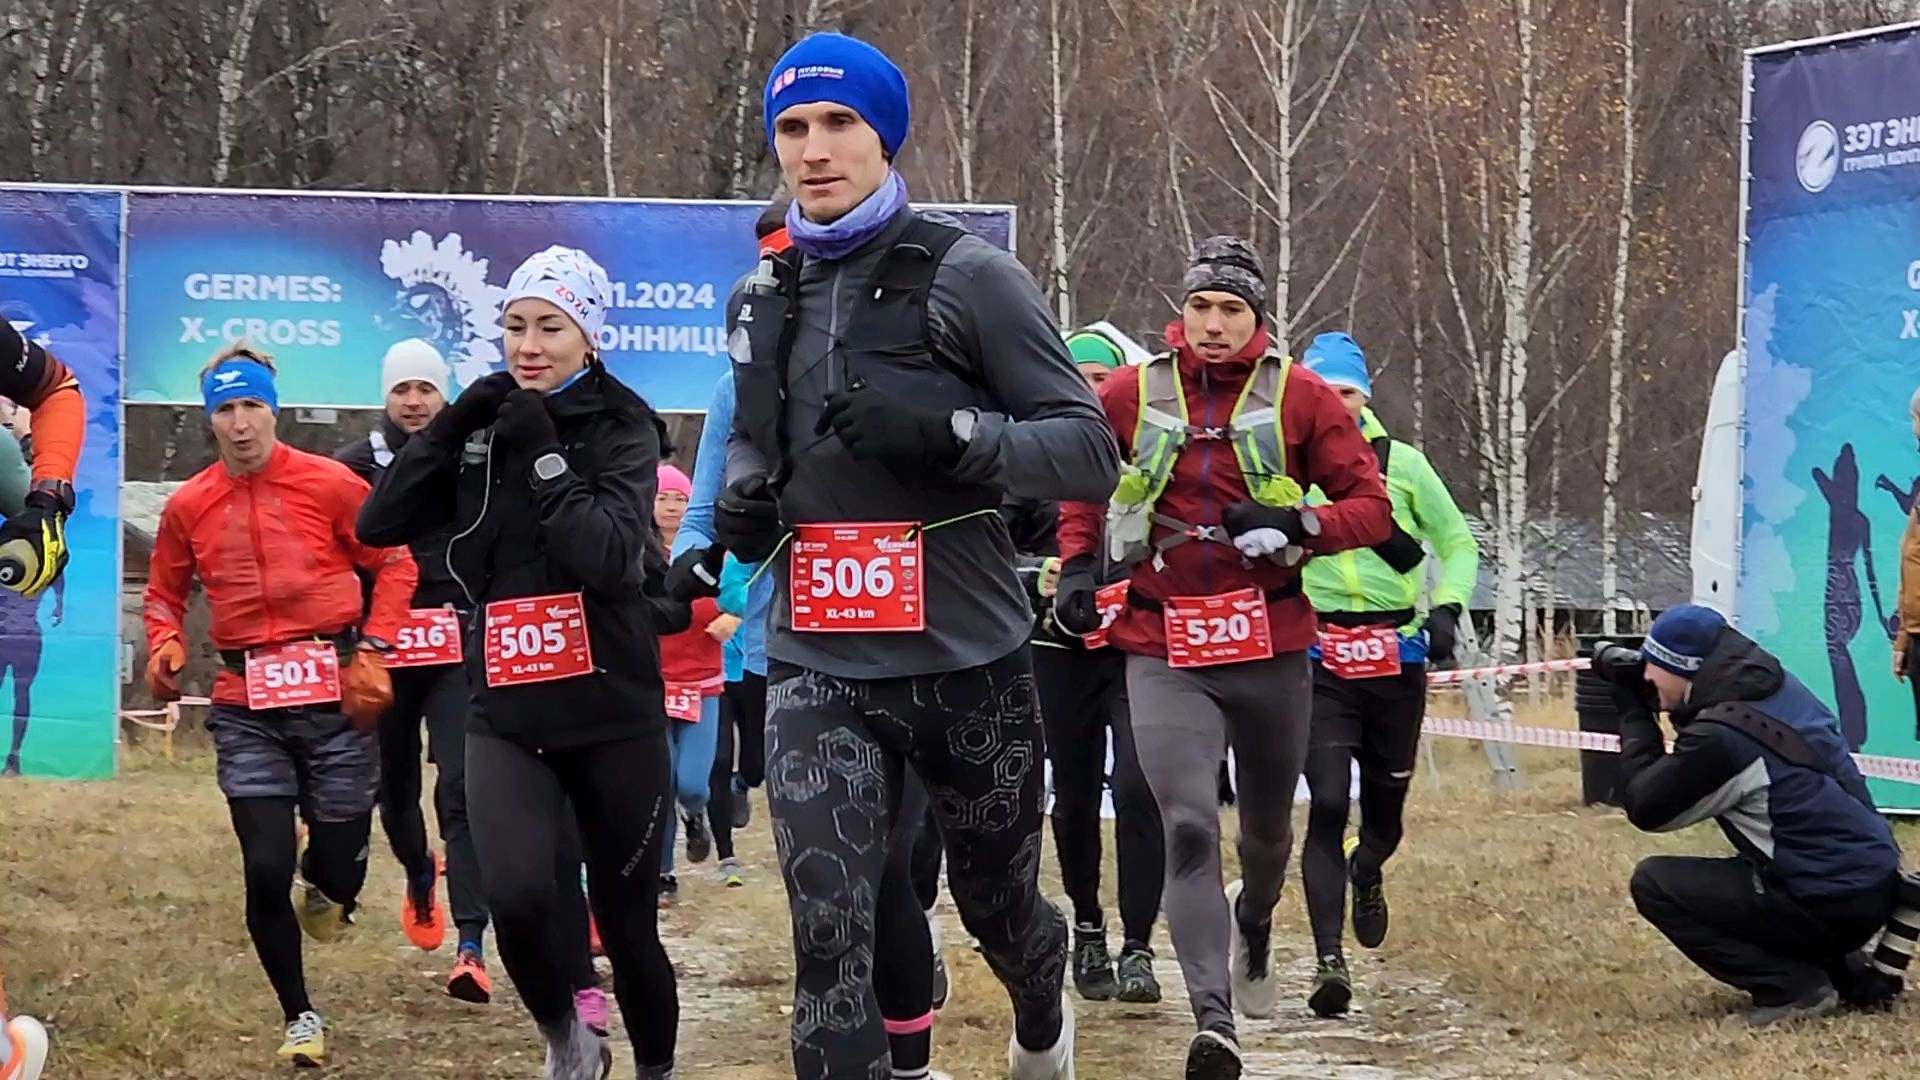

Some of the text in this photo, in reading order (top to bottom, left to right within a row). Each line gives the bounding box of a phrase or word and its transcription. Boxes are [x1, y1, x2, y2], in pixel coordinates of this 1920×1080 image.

[1843, 121, 1885, 153] ЗЭТ
[17, 253, 89, 270] ЭНЕРГО
[183, 272, 342, 303] GERMES:
[555, 284, 589, 320] ZOZH
[179, 317, 342, 346] X-CROSS
[1900, 309, 1920, 339] X
[811, 556, 894, 598] 506
[825, 607, 875, 619] XL-43 km
[396, 625, 446, 650] 516
[500, 622, 567, 659] 505
[1186, 613, 1251, 646] 520
[1335, 637, 1386, 663] 503
[264, 659, 322, 688] 501
[665, 695, 690, 712] 13
